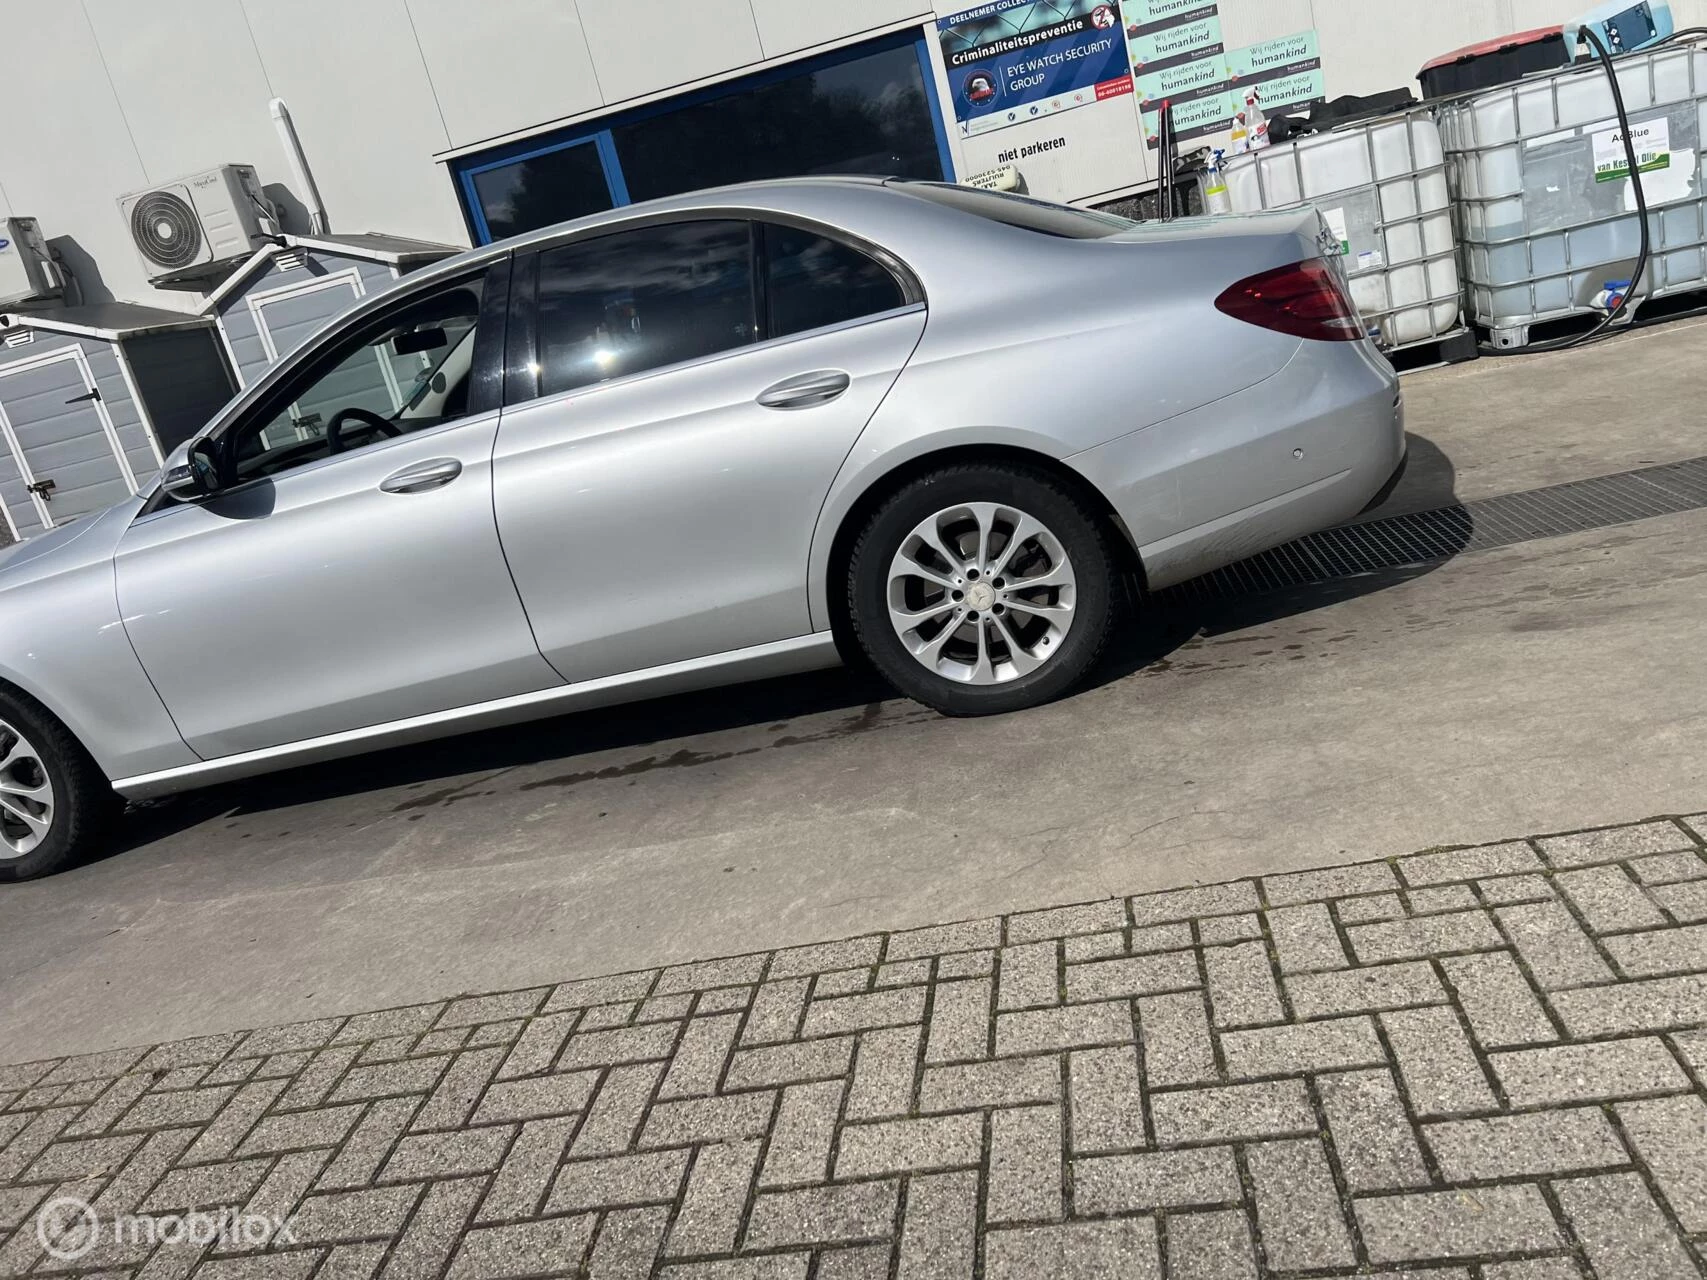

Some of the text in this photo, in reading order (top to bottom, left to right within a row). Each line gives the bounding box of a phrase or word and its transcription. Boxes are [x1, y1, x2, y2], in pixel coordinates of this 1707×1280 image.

[949, 0, 1030, 25] DEELNEMER COLLE
[1149, 0, 1202, 15] humanki
[952, 19, 1084, 65] Criminaliteitspreventie
[1153, 23, 1207, 42] Wij rijden voor
[1156, 30, 1210, 53] humankind
[1249, 37, 1304, 55] Wij rijden voor
[1251, 44, 1307, 67] humankind
[1007, 38, 1112, 77] EYE WATCH SECURITY
[1160, 61, 1212, 80] Wij rijden voor
[1161, 68, 1215, 91] humankind
[1010, 73, 1045, 91] GROUP
[1270, 80, 1291, 90] rijden
[1293, 76, 1310, 84] voor
[1258, 83, 1313, 104] humankind
[1174, 105, 1221, 126] umankind
[1180, 103, 1200, 113] rijden
[1202, 98, 1219, 106] voor
[998, 137, 1066, 163] niet parkeren
[1597, 161, 1611, 172] van
[1613, 155, 1639, 170] Kesl
